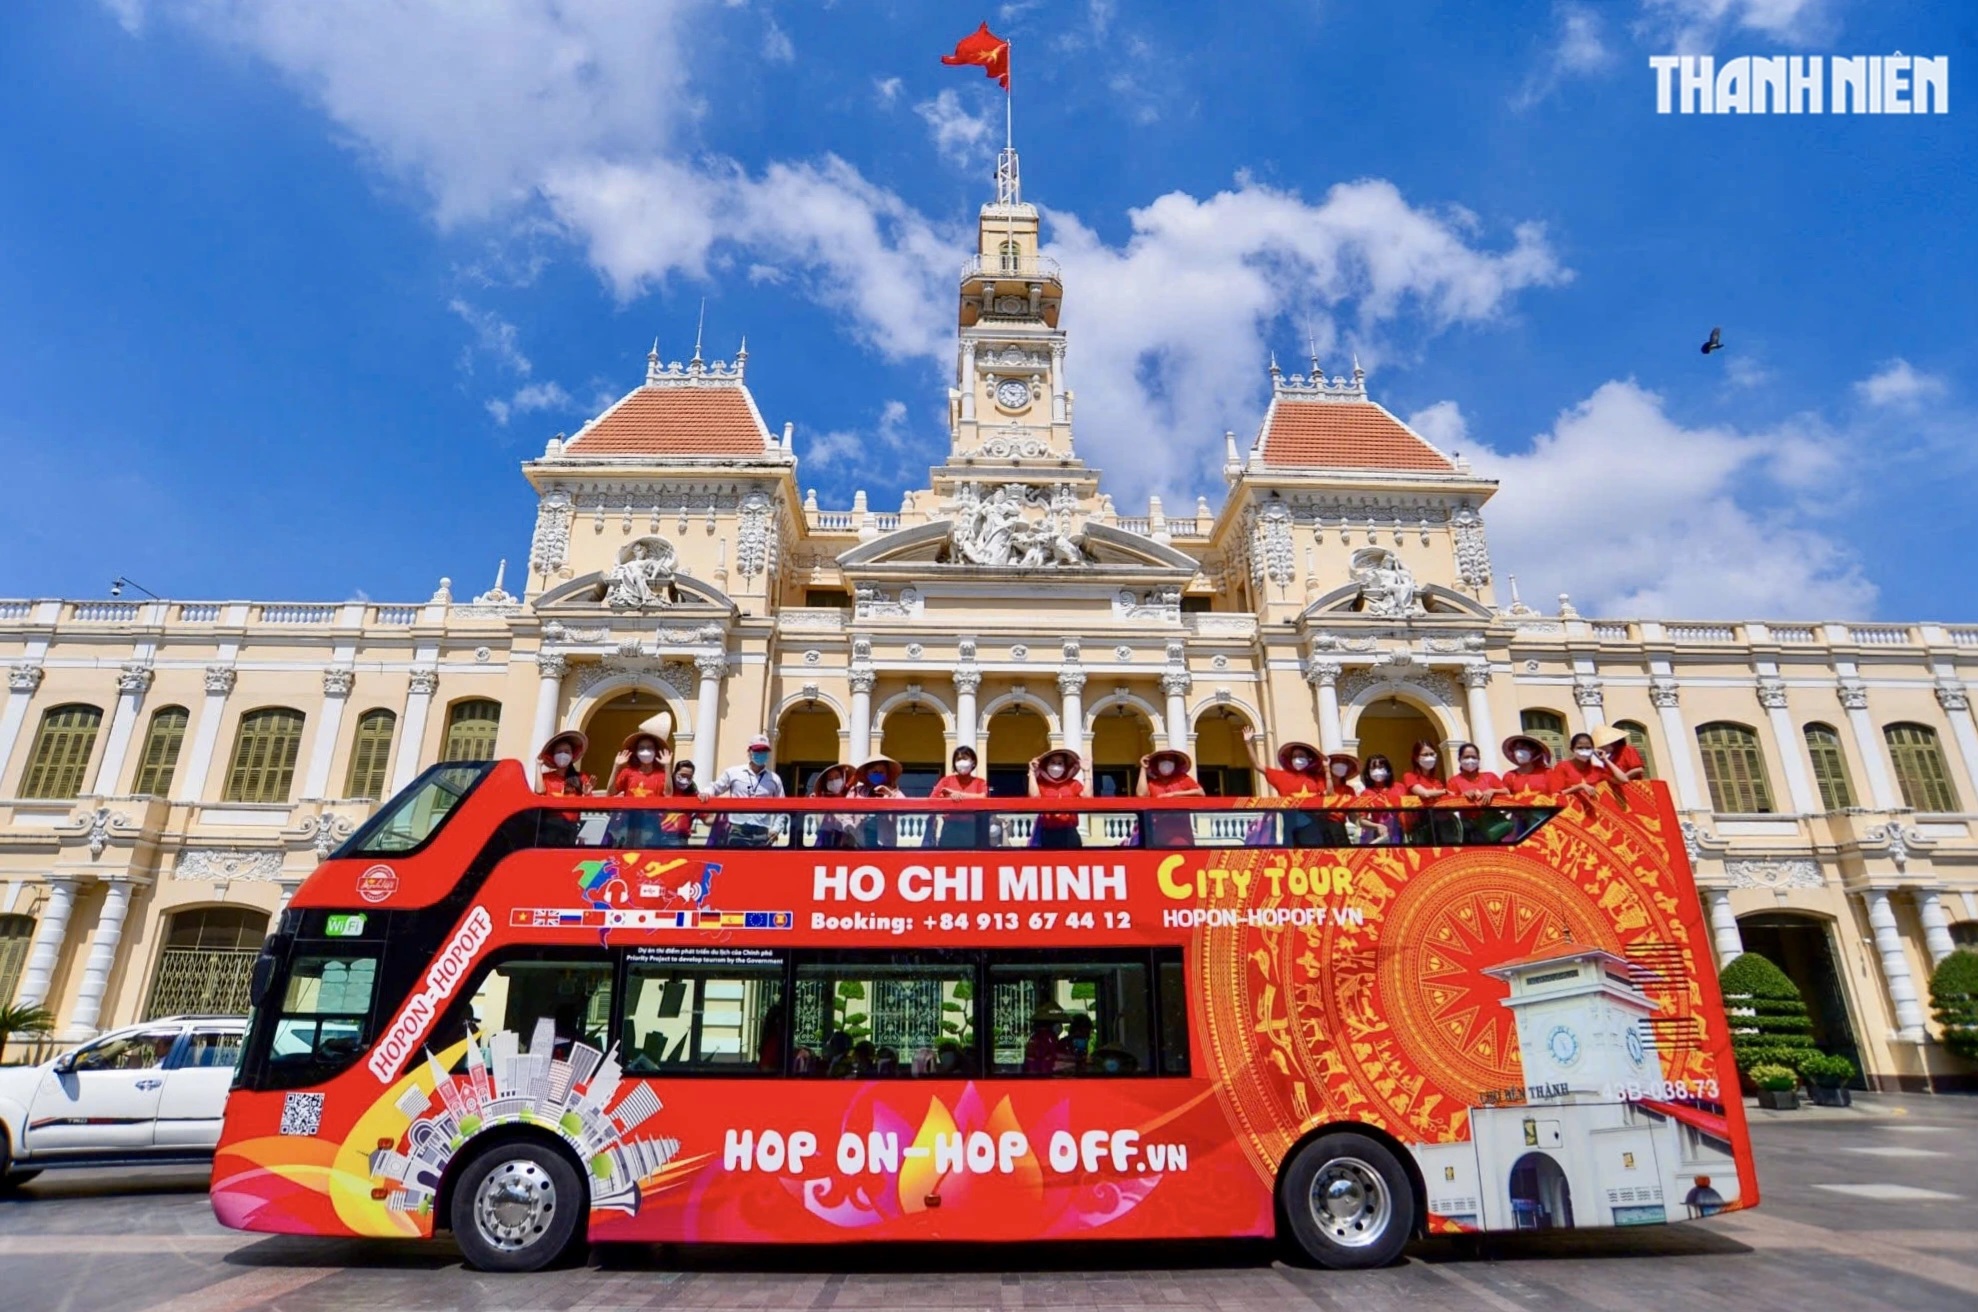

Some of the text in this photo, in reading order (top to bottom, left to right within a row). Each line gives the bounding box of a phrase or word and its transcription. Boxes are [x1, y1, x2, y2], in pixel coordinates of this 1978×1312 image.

[813, 866, 1127, 901] HO CHI MINH
[1158, 854, 1354, 899] CITY TOUR
[811, 911, 1131, 934] Booking: +84 913 67 44 12
[1163, 906, 1364, 928] HOPON-HOPOFF.VN
[626, 955, 648, 963] Priority
[649, 955, 670, 963] Project
[678, 956, 703, 964] develop
[727, 957, 735, 965] by
[374, 1000, 429, 1077] HOPON
[432, 912, 487, 992] HOPOFF
[724, 1129, 817, 1173] HOP
